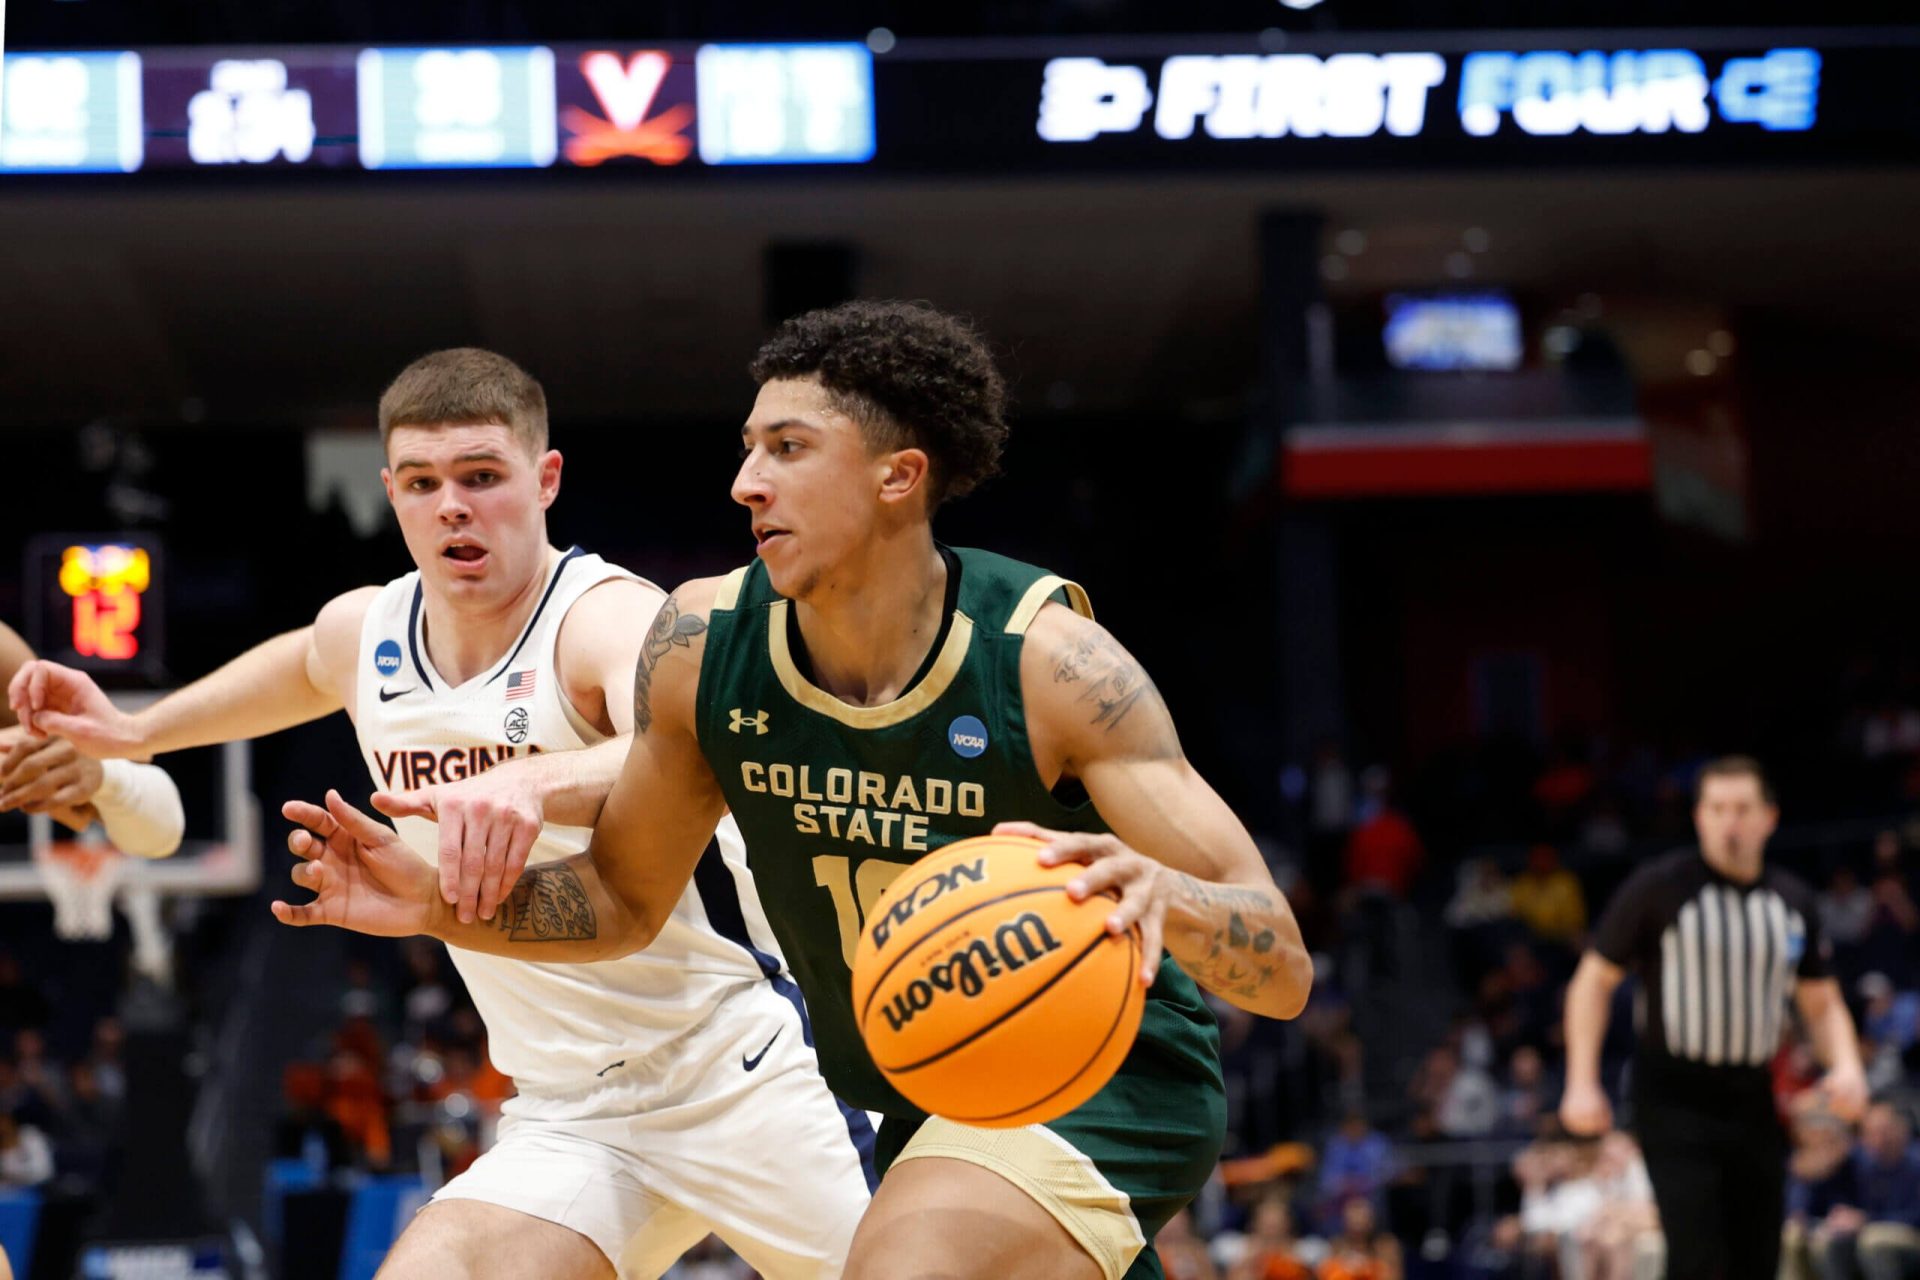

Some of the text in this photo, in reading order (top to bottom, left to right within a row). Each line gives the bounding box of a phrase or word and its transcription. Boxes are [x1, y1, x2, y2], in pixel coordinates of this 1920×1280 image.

[1153, 48, 1709, 139] FIRST FOUR
[508, 717, 528, 729] ACC
[953, 734, 985, 750] NCAA
[374, 744, 542, 792] VIRGIN
[741, 761, 985, 818] COLORADO
[794, 803, 929, 851] STATE
[872, 858, 985, 950] NCAA
[880, 912, 1062, 1032] Wilson
